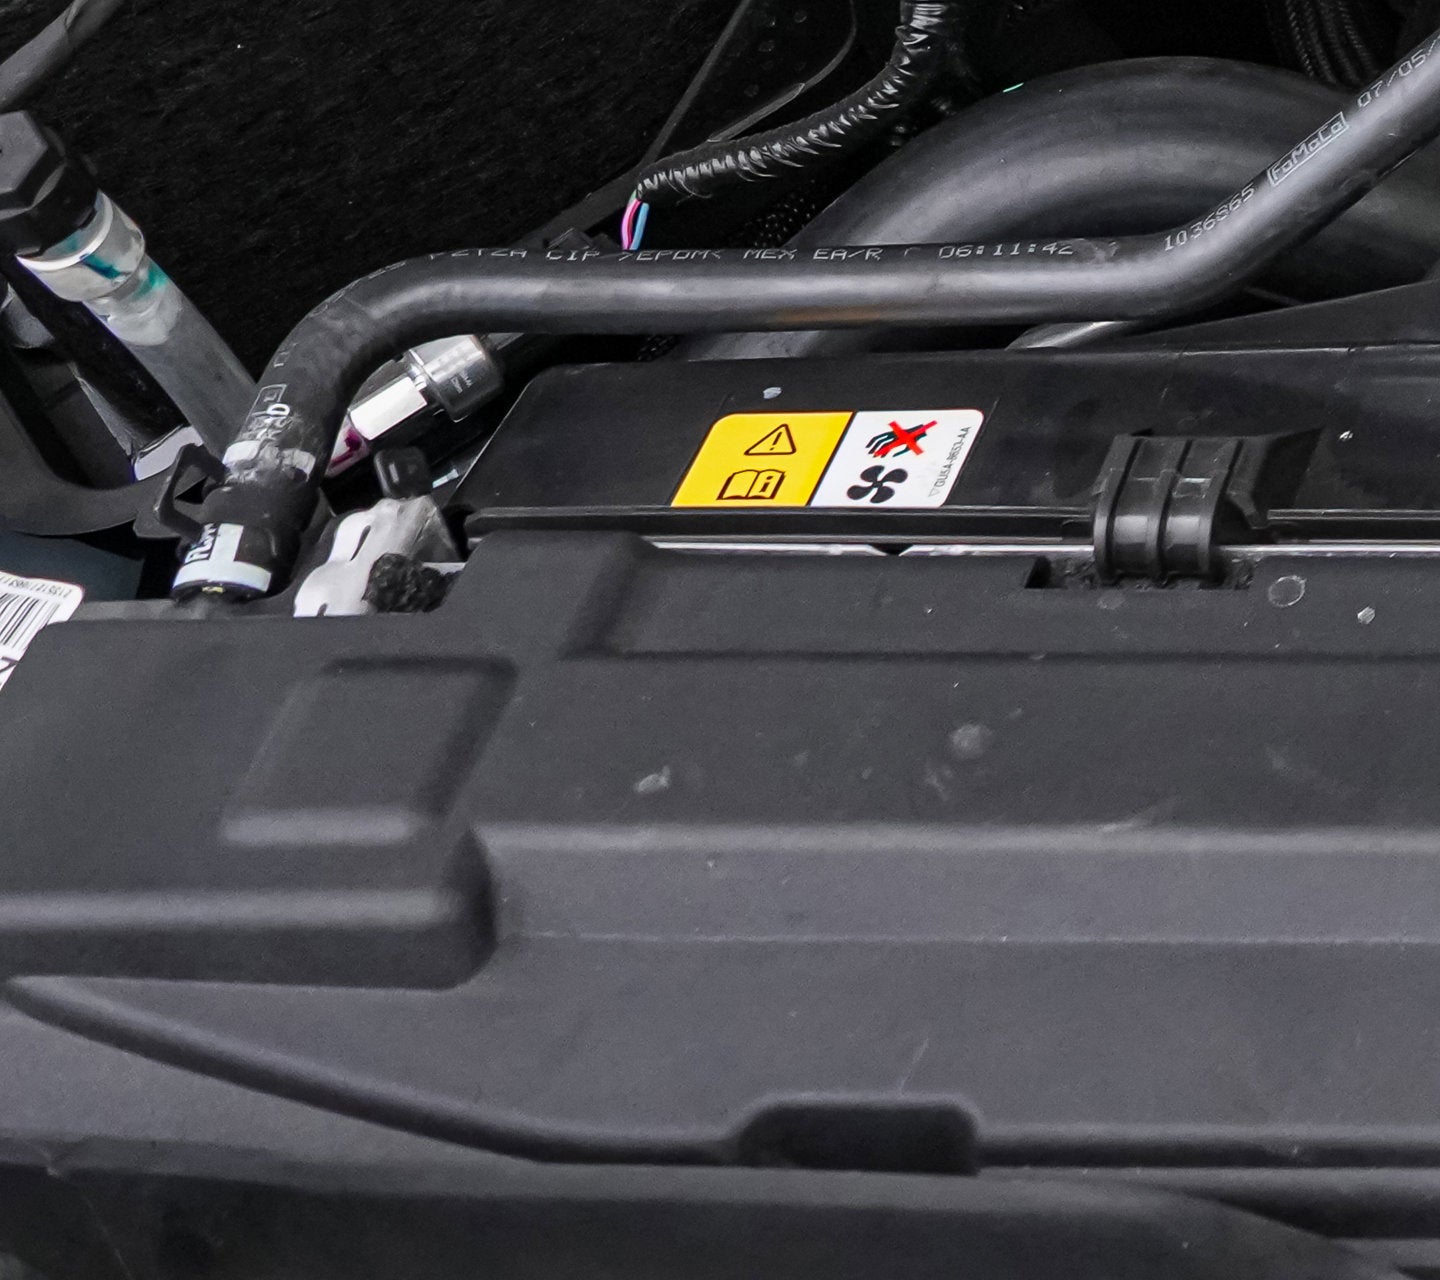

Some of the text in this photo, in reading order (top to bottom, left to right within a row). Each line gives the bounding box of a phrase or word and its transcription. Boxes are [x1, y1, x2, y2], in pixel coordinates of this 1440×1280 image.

[1271, 116, 1346, 182] FoMoCo
[743, 248, 797, 260] MEX
[813, 247, 882, 261] EA/R
[938, 241, 1073, 259] 06:11:42
